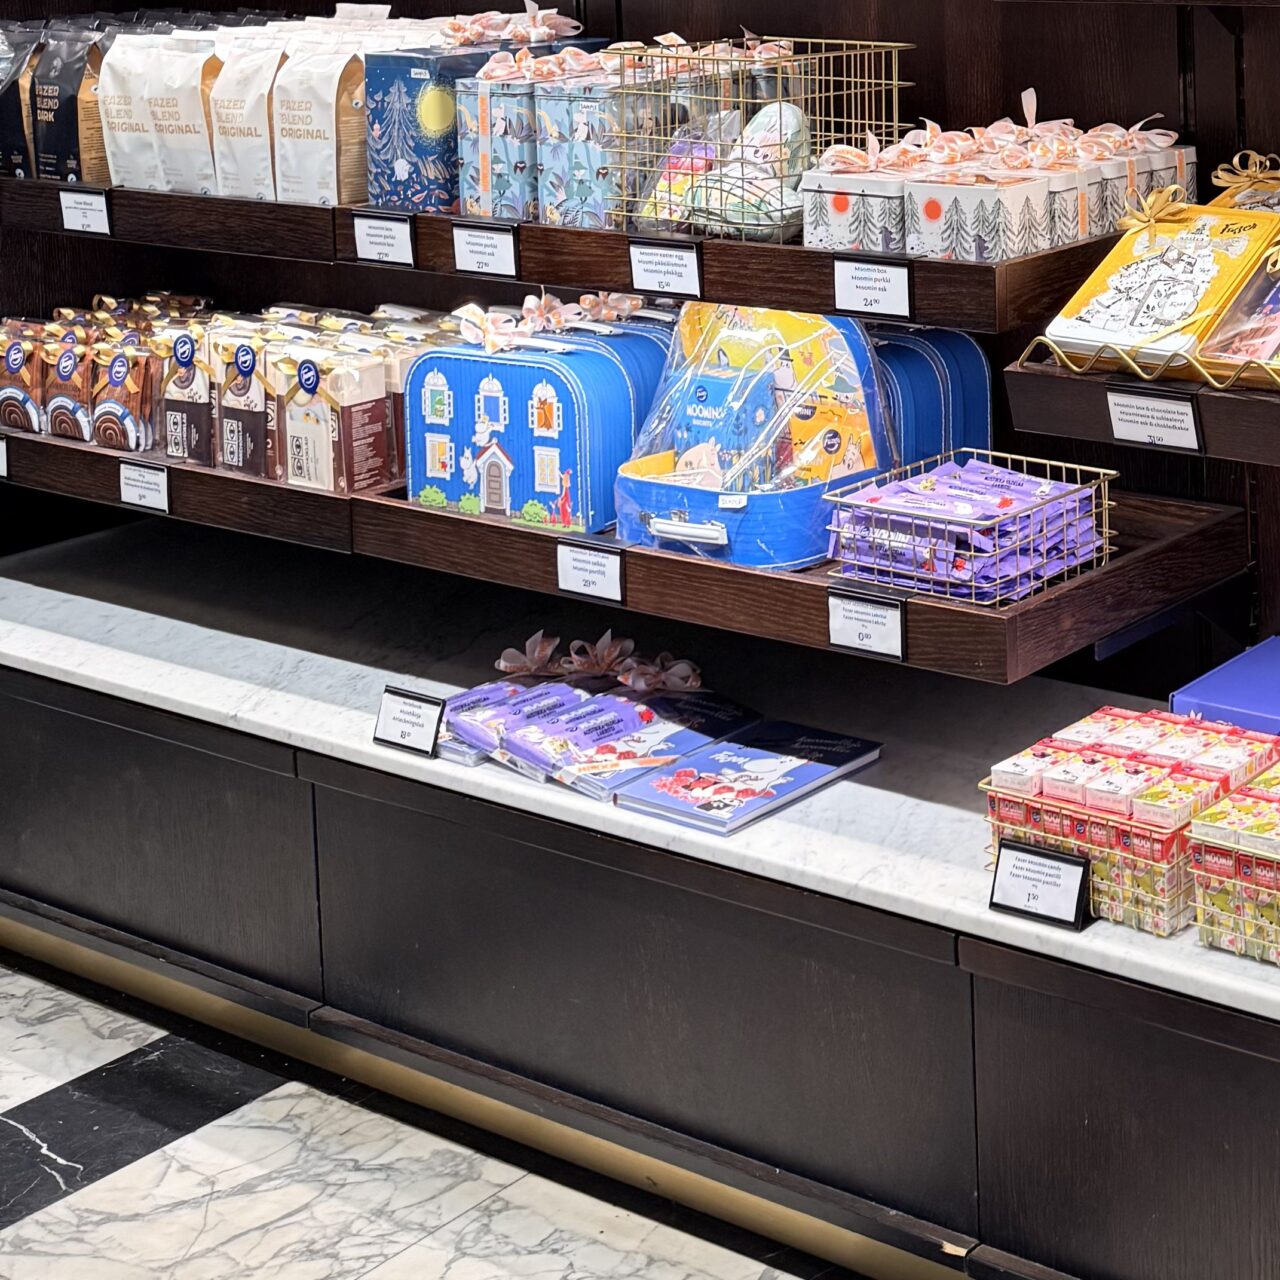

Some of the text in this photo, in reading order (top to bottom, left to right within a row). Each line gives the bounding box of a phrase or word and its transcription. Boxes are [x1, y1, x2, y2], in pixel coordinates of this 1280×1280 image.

[280, 101, 312, 111] FAZER
[280, 114, 312, 125] BLEND
[281, 127, 329, 140] ORIGINAL
